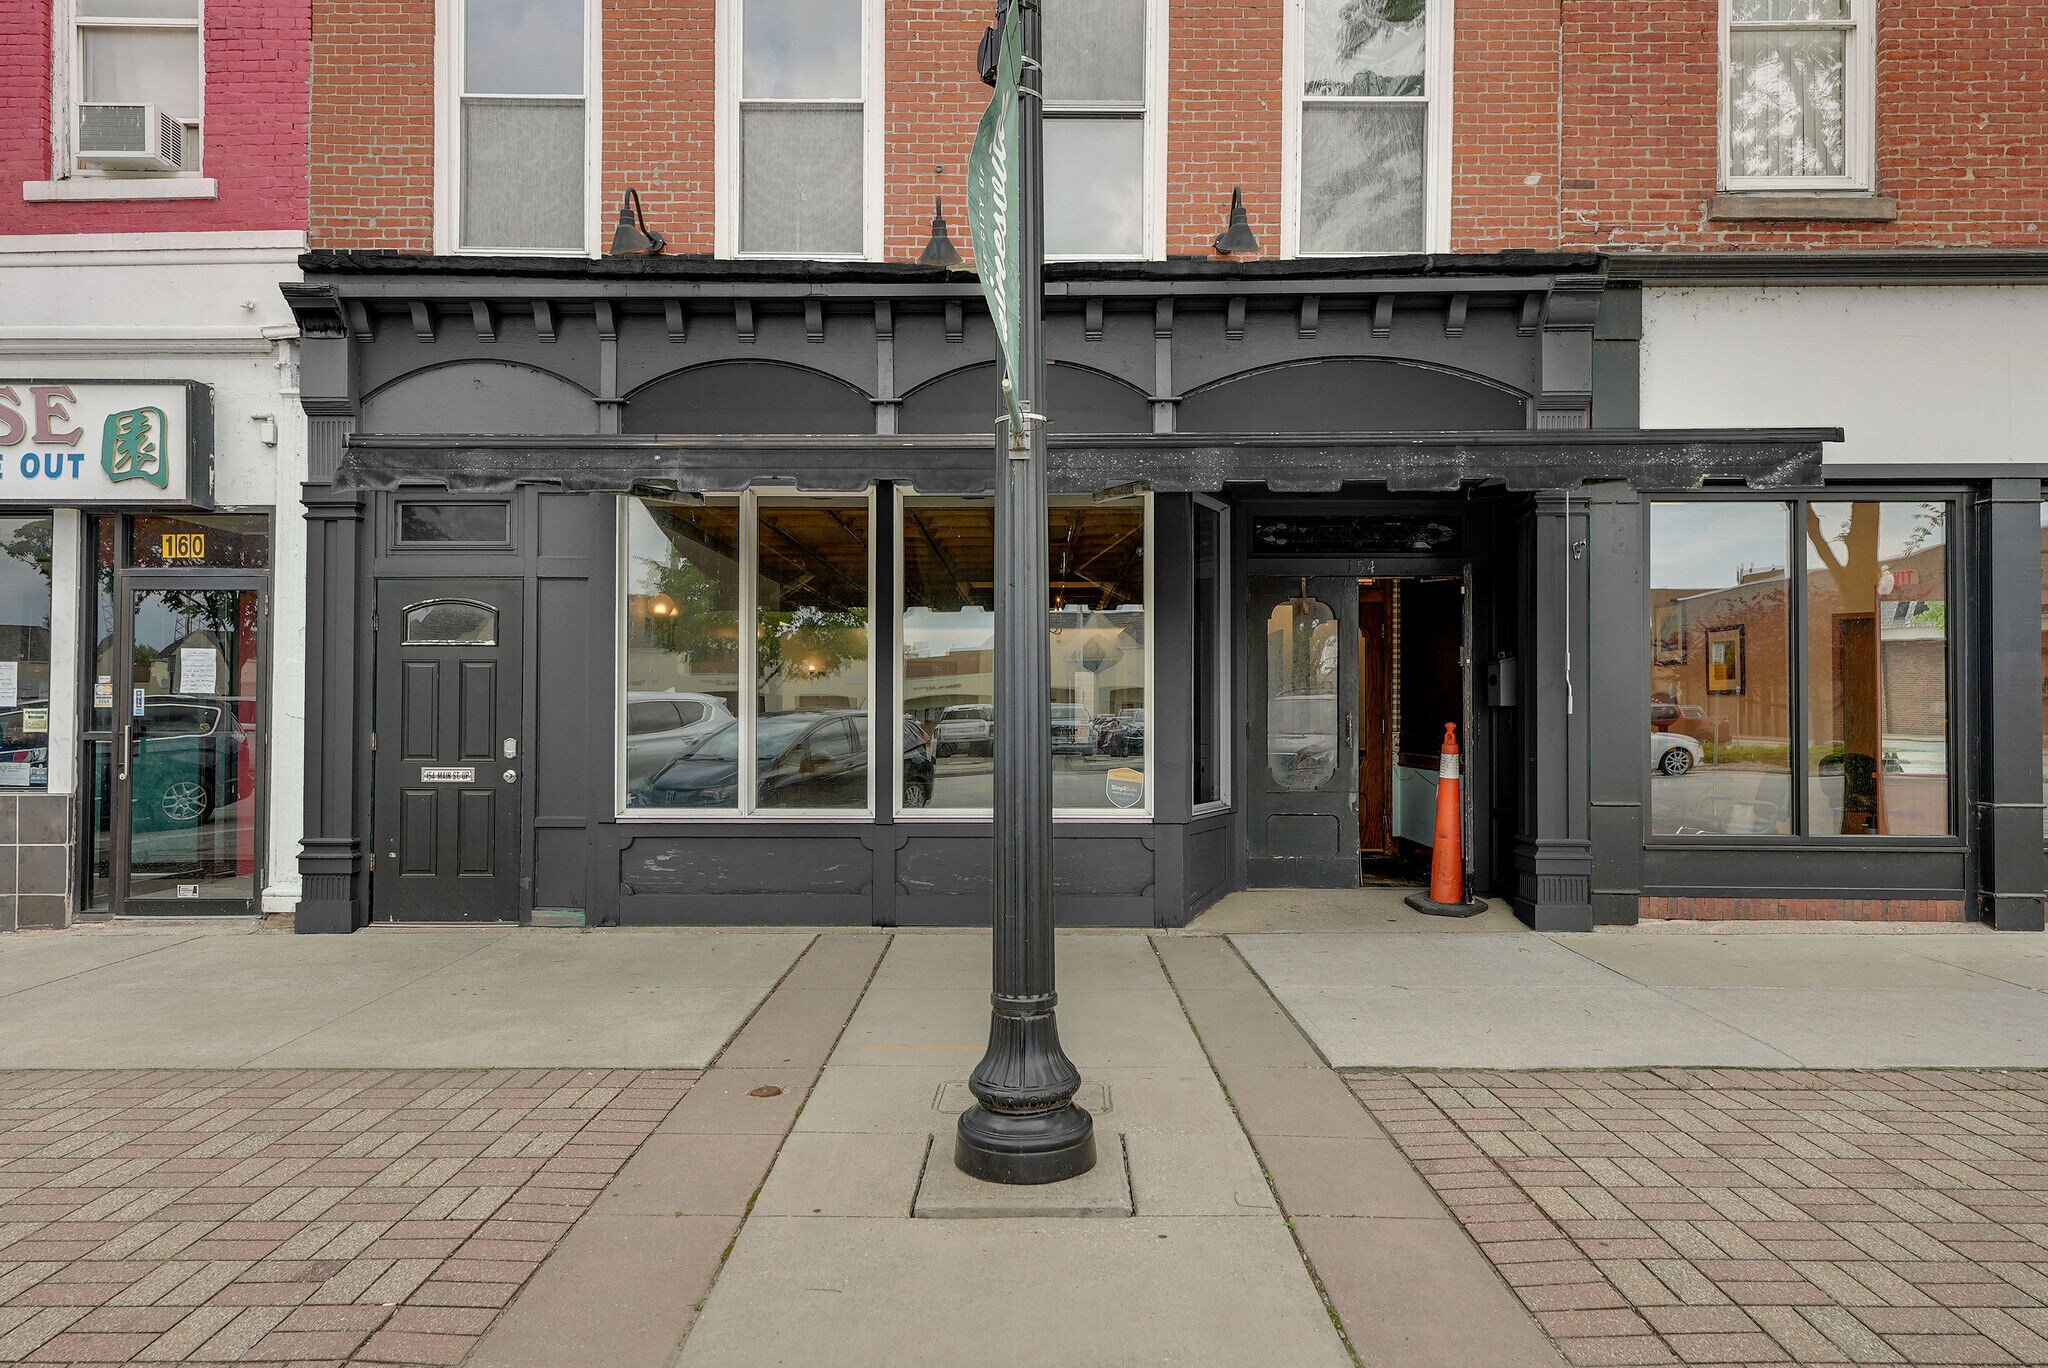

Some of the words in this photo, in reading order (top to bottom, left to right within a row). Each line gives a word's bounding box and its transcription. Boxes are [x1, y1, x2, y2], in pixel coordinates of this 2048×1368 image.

[979, 163, 985, 188] OF
[20, 452, 85, 479] OUT
[165, 535, 203, 557] 160
[1347, 559, 1375, 575] 154
[437, 771, 451, 780] MAIN
[461, 771, 469, 780] UP
